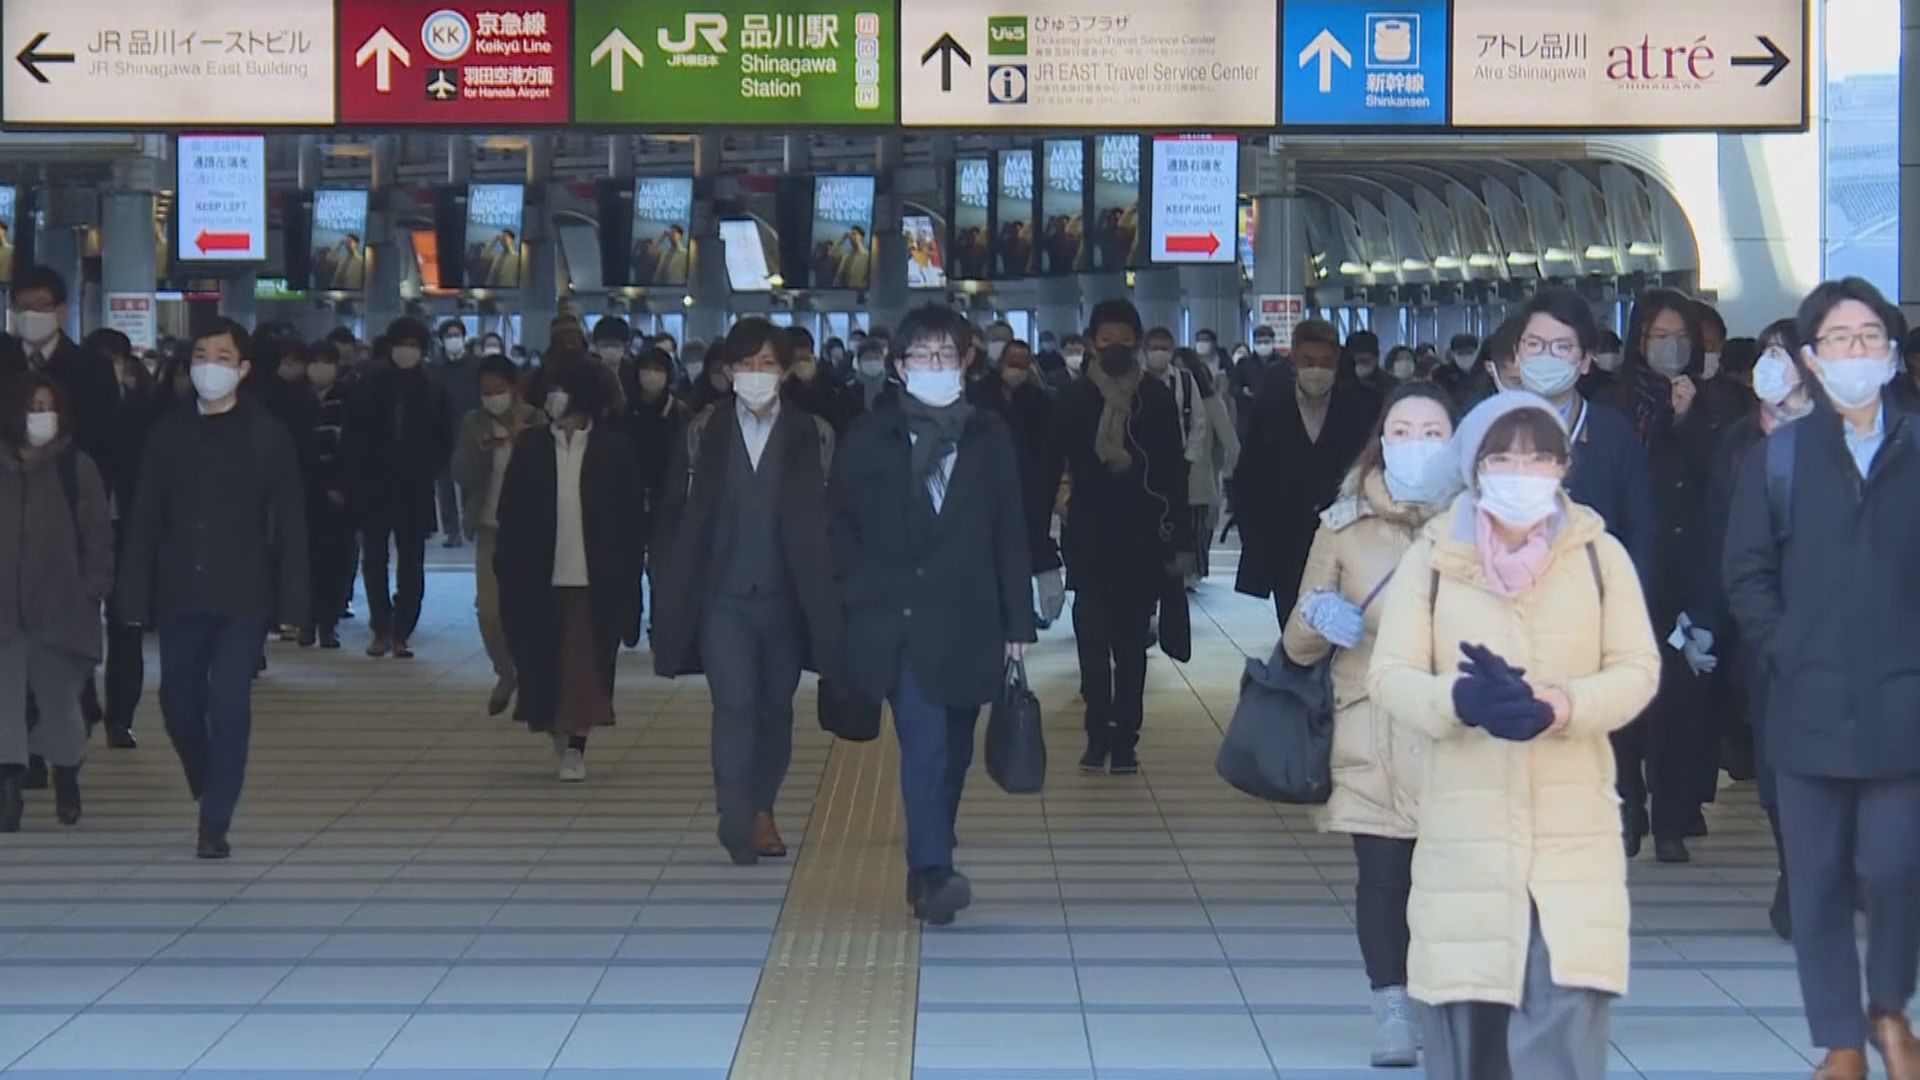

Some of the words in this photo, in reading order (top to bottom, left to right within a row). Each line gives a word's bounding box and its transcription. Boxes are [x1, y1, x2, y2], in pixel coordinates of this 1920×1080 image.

[476, 11, 547, 36] 京急線
[657, 12, 728, 53] JR
[741, 14, 839, 49] 品川駅
[1034, 15, 1130, 32] びゅうプラザ
[88, 30, 121, 53] JR
[129, 29, 311, 56] 品川イーストビル
[432, 27, 460, 43] KK
[1084, 36, 1104, 45] and
[1107, 36, 1138, 45] Travel
[1141, 36, 1179, 45] Service
[1182, 35, 1216, 45] Center
[523, 38, 552, 53] Line
[1476, 33, 1587, 60] アトレ品川
[667, 54, 720, 67] JR東日本
[1606, 32, 1715, 80] atré
[88, 61, 108, 75] JR
[114, 60, 200, 79] Shinagawa
[207, 61, 241, 75] East
[247, 60, 308, 79] Building
[741, 54, 837, 77] Shinagawa
[1035, 64, 1054, 81] JR
[1059, 63, 1099, 81] EAST
[1105, 63, 1149, 81] Travel
[1153, 62, 1206, 81] Service
[1211, 61, 1259, 81] Center
[1508, 64, 1587, 82] Shinagawa
[464, 66, 553, 86] 羽田空港方面
[1366, 72, 1424, 93] 新幹線
[464, 87, 477, 98] for
[479, 87, 516, 98] Haneda
[518, 86, 550, 99] Airport
[741, 78, 801, 98] Station
[1366, 94, 1430, 108] Shinkansen
[195, 201, 221, 212] KEEP
[223, 201, 247, 212] LEFT
[472, 202, 517, 214] BEYOND
[639, 196, 684, 209] BEYOND
[819, 196, 867, 209] BEYOND
[1166, 204, 1192, 214] KEEP
[1193, 203, 1221, 214] RIGHT
